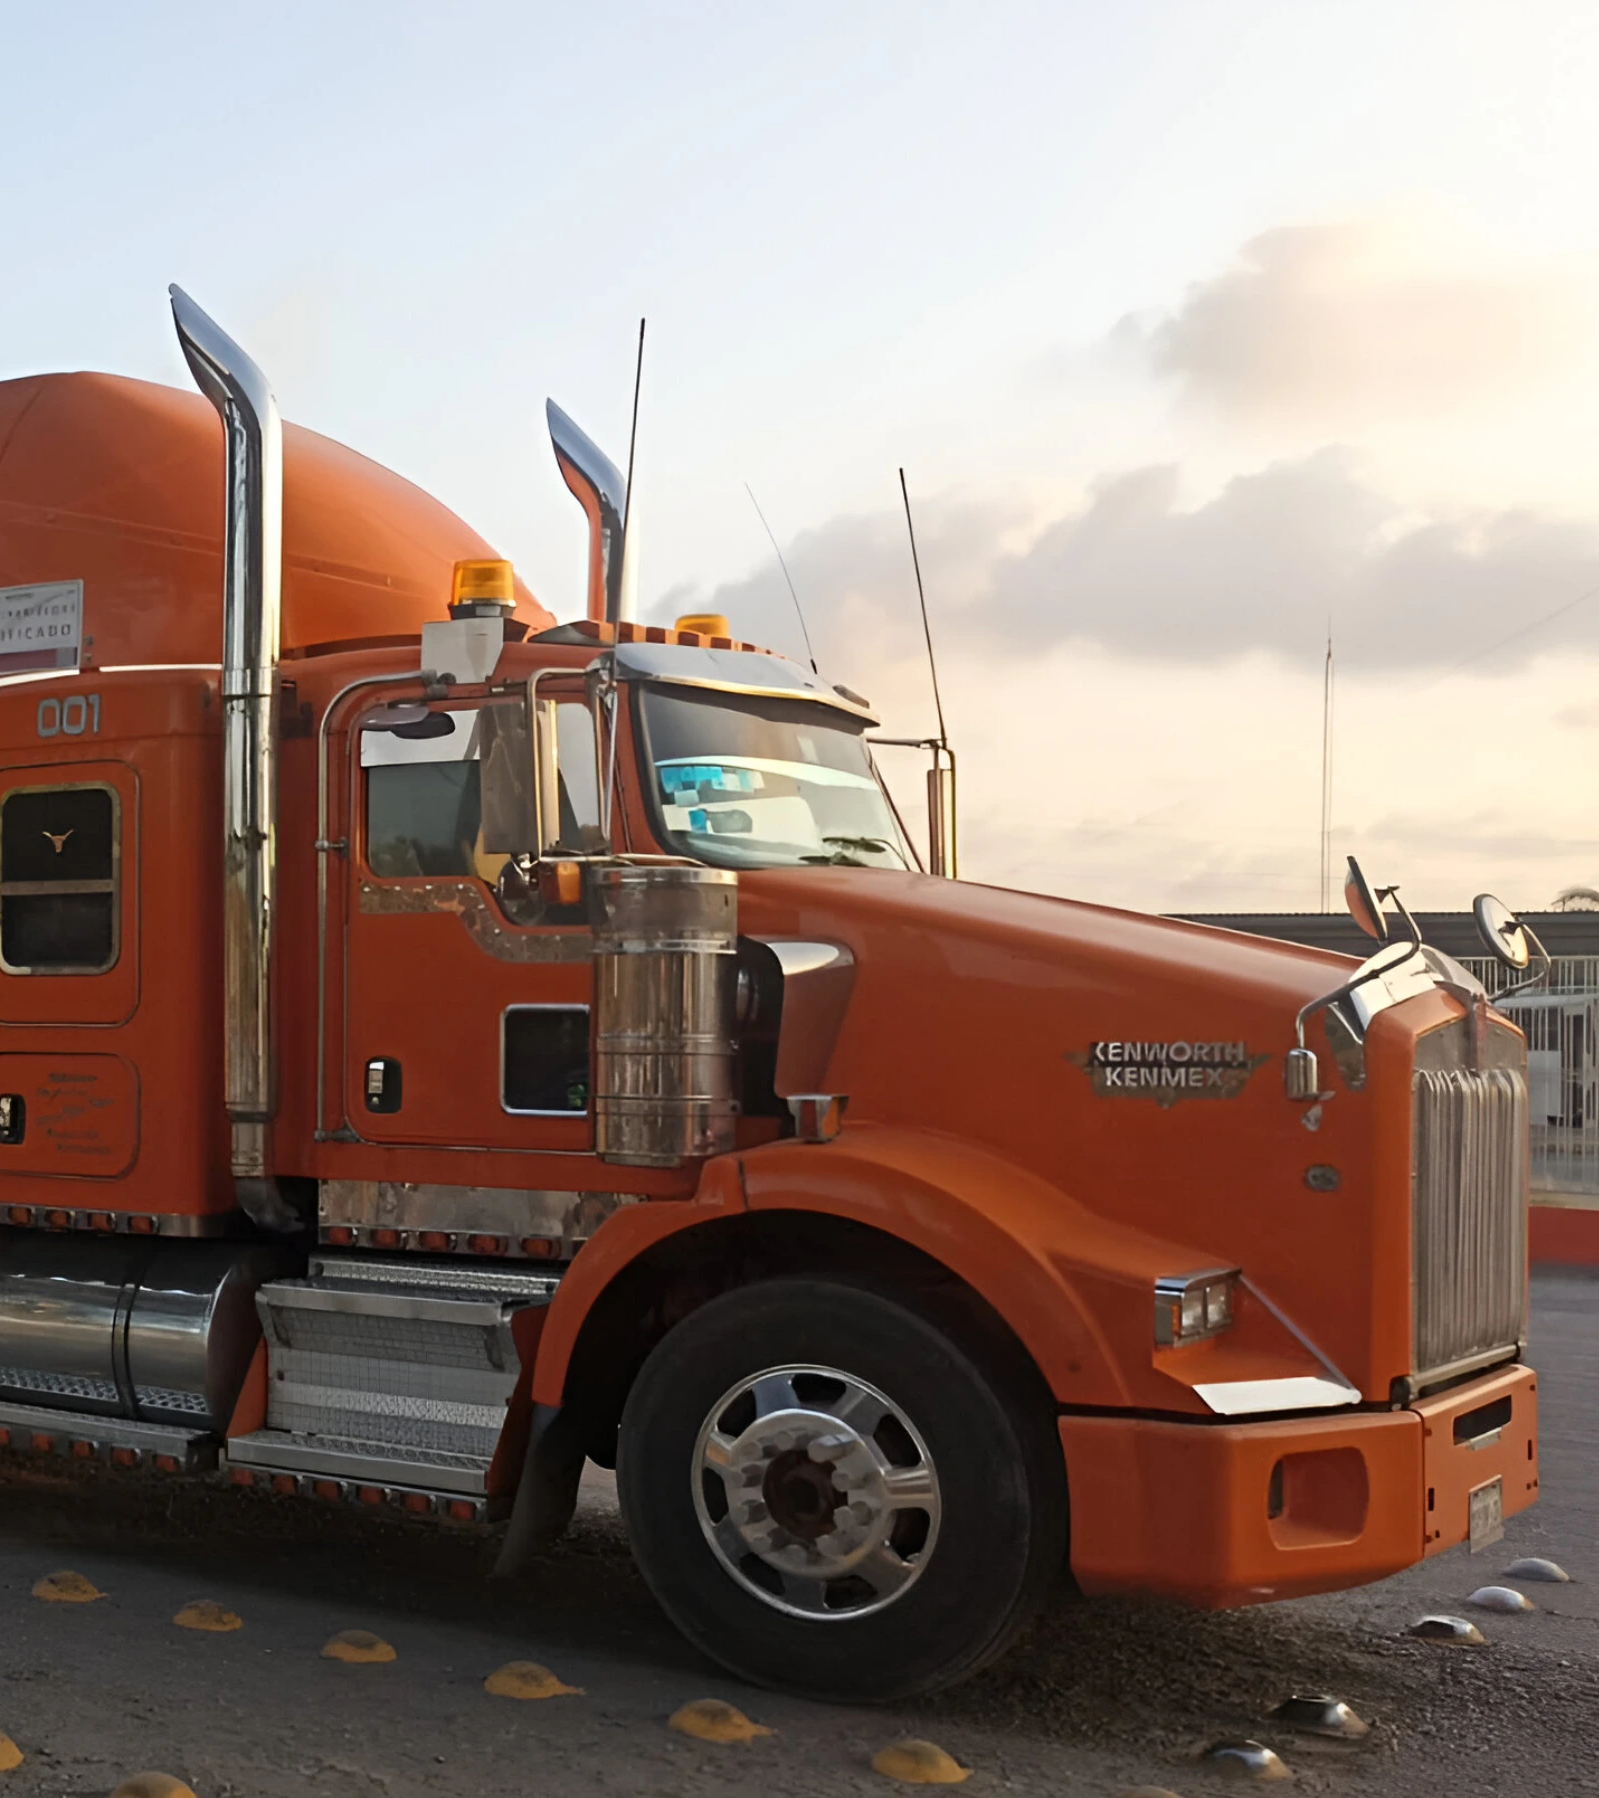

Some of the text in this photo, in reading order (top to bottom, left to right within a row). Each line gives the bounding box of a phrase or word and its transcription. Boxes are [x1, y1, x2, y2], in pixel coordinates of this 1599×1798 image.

[37, 694, 100, 738] 001
[1091, 1042, 1244, 1062] KENWORTH
[1105, 1067, 1224, 1087] KENMEX
